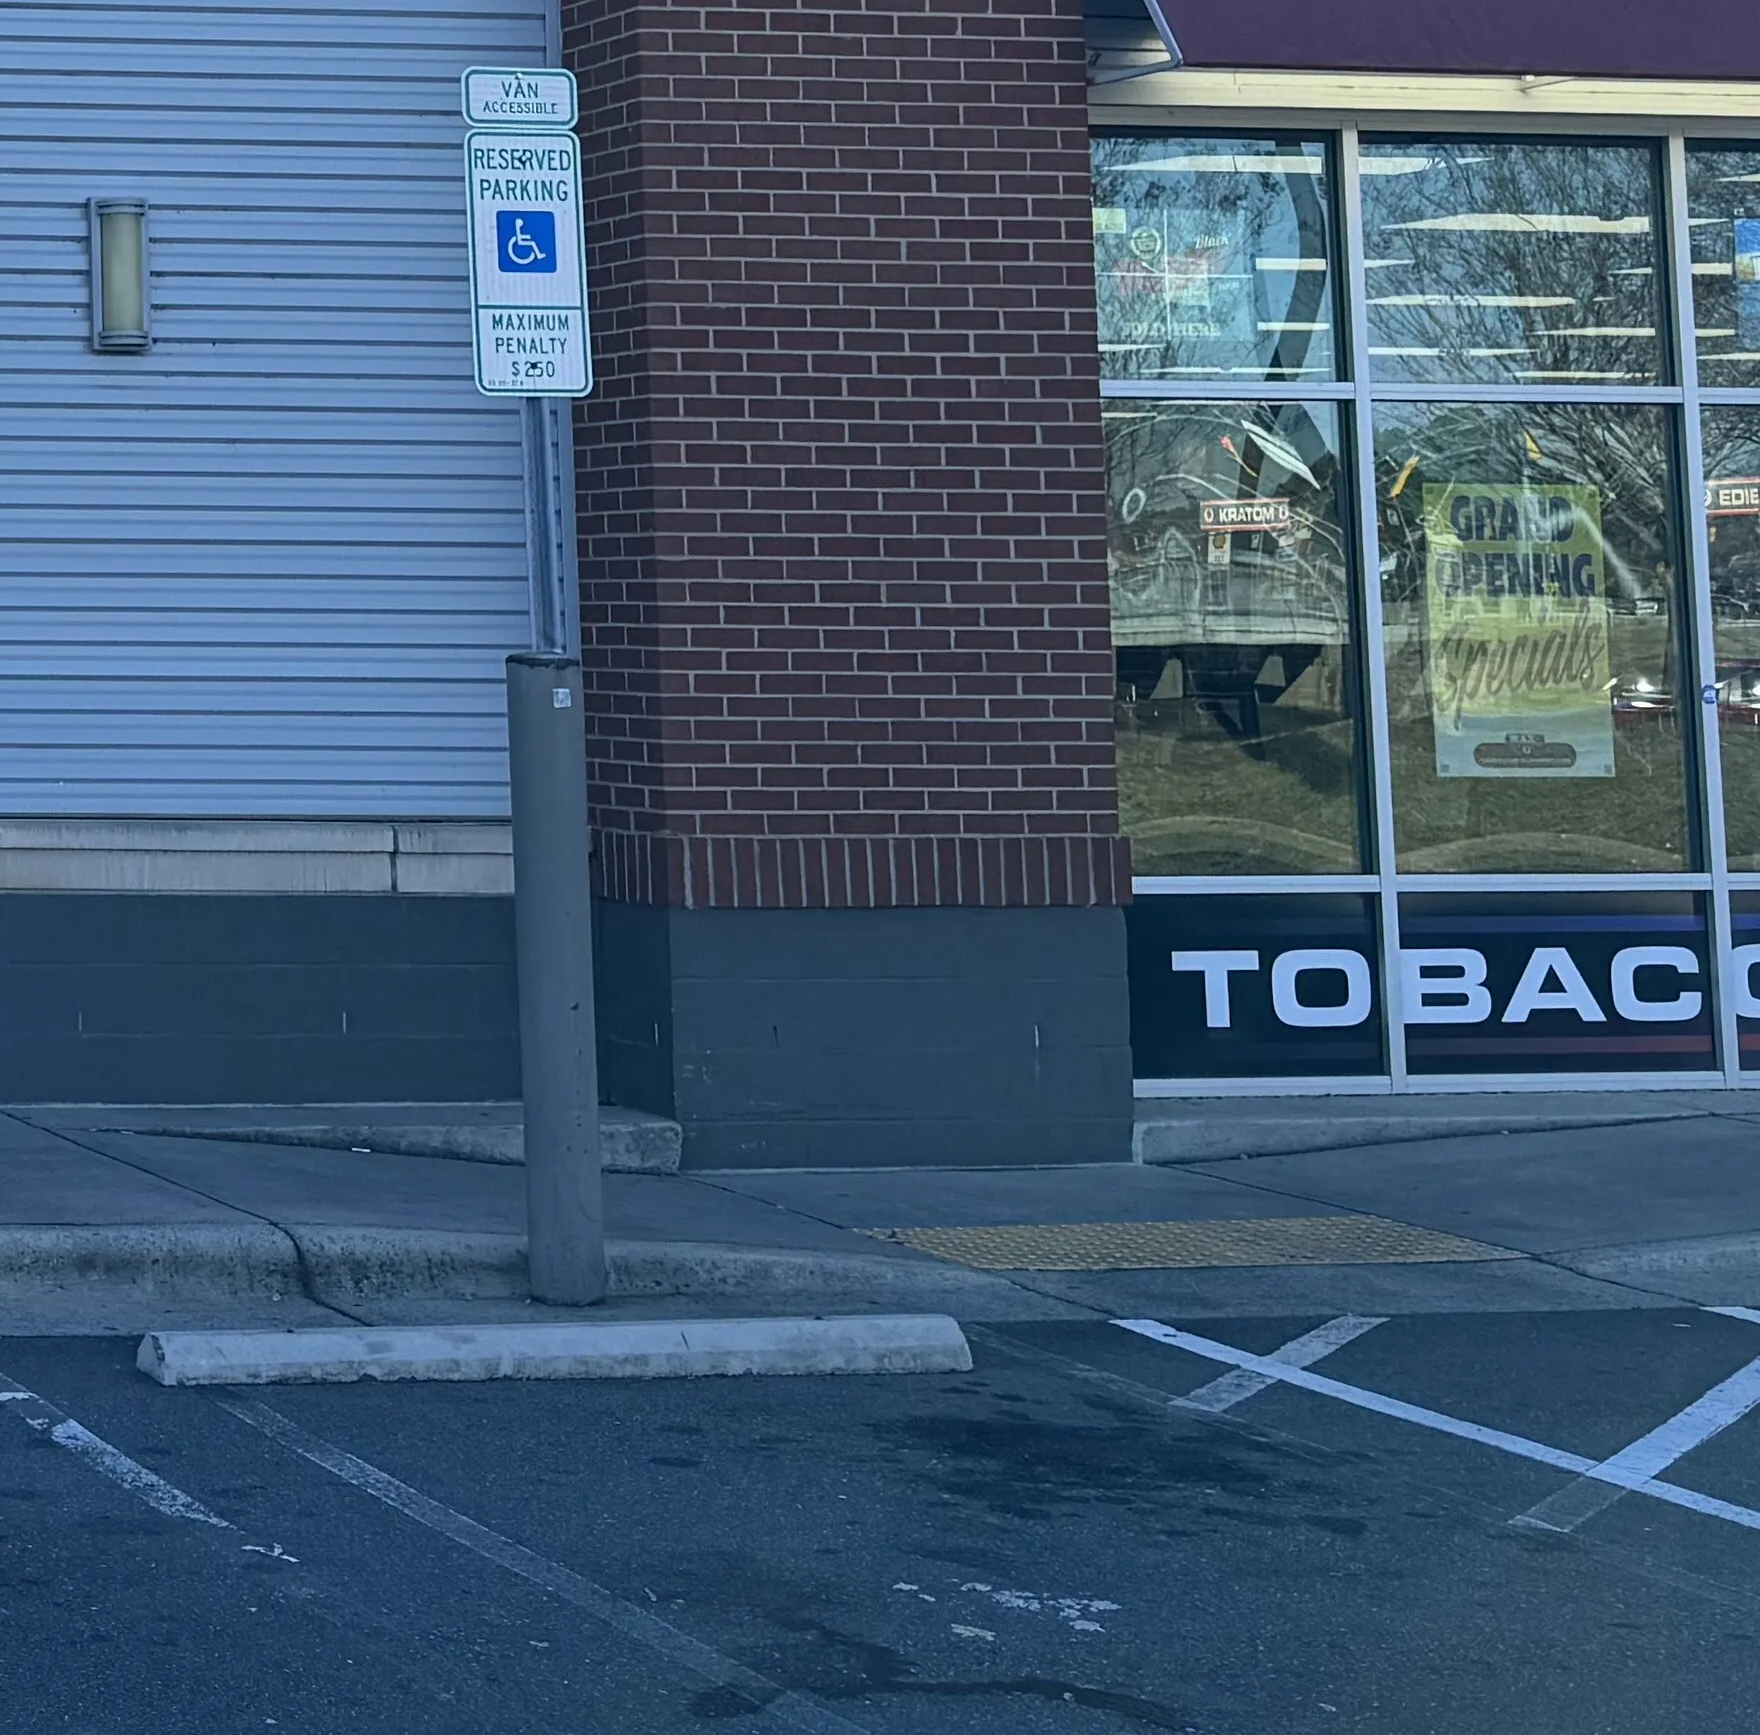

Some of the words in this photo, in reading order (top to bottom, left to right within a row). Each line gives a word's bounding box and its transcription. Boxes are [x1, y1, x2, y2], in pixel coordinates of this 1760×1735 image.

[501, 79, 539, 99] VAN
[483, 100, 558, 114] ACCESSIBLE
[474, 148, 571, 171] RESERVED
[480, 179, 568, 202] PARKING
[492, 314, 570, 332] MAXIMUM
[495, 337, 568, 354] PENALTY
[1218, 505, 1275, 523] KRATOM
[1450, 495, 1575, 543] GRAND
[1435, 553, 1596, 598] OPENING
[1433, 596, 1606, 732] Specials
